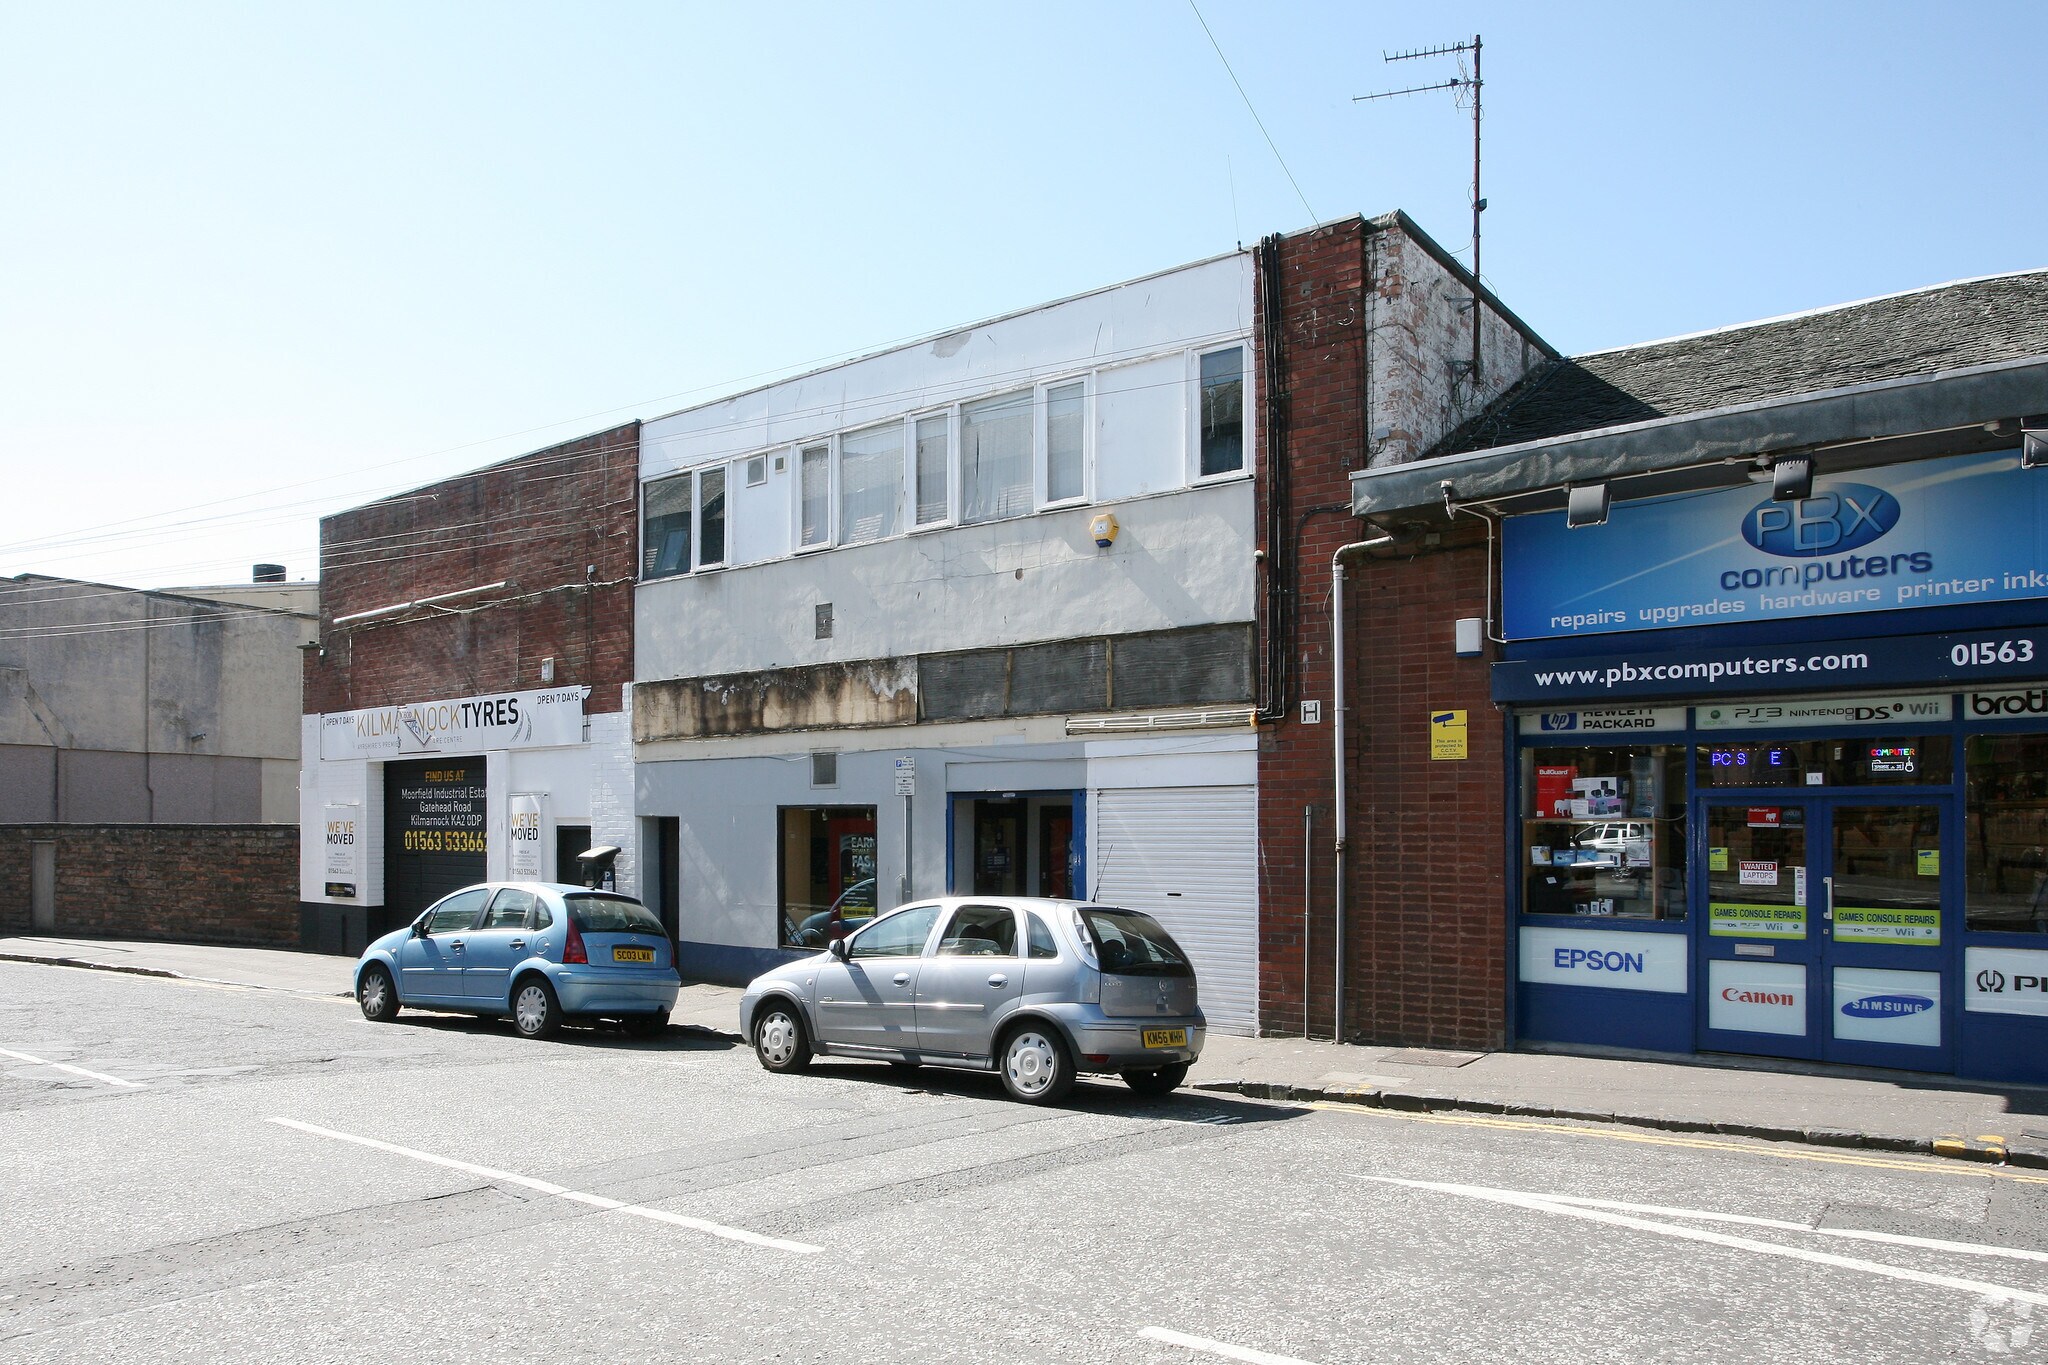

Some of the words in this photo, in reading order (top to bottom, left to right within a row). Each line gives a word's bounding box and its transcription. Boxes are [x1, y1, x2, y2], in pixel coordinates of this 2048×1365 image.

[1756, 491, 1884, 551] PBX
[1720, 552, 1933, 590] computers
[1551, 609, 1626, 630] repairs
[1639, 599, 1746, 624] upgrades
[1760, 588, 1881, 611] hardware
[1897, 578, 1995, 603] printer
[2003, 570, 2048, 590] ink
[1534, 652, 1868, 687] www.pbxcomputers.com
[1951, 640, 2034, 667] 01563
[537, 694, 555, 705] OPEN
[556, 693, 561, 703] 7
[562, 692, 579, 702] DAYS
[1303, 702, 1318, 722] H
[1735, 707, 1783, 718] PS3
[1790, 707, 1845, 718] NINTENDO
[1909, 702, 1939, 715] Wii
[326, 716, 339, 726] OPEN
[339, 716, 342, 725] 7
[343, 715, 354, 725] DAYS
[1550, 713, 1568, 730] hp
[1583, 718, 1655, 730] PACKARD
[1712, 752, 1732, 766] PC
[1736, 752, 1746, 766] S
[1770, 751, 1781, 765] E
[1870, 748, 1915, 757] COMPUTER
[425, 770, 443, 782] FIND
[443, 770, 454, 782] US
[455, 769, 465, 781] AT
[401, 787, 433, 800] Moorfield
[434, 786, 467, 799] Industrial
[420, 801, 452, 813] Gatehead
[453, 800, 472, 812] Road
[411, 814, 450, 826] Kilmarnock
[451, 814, 465, 826] KA2
[511, 813, 538, 827] WE'VE
[327, 821, 354, 833] WE'VE
[511, 827, 538, 840] MOVED
[327, 833, 354, 845] MOVED
[404, 830, 442, 851] 01563
[604, 871, 611, 880] P
[1743, 871, 1774, 879] LAPTOPS
[1714, 908, 1738, 918] GAMES
[1739, 908, 1772, 919] CONSOLE
[1773, 910, 1802, 919] REPAIRS
[1838, 912, 1864, 922] GAMES
[1866, 913, 1902, 924] CONSOLE
[1904, 914, 1935, 925] REPAIRS
[1765, 922, 1783, 931] Wii
[1895, 927, 1915, 936] Wii
[616, 950, 637, 960] SC03
[1554, 948, 1643, 973] EPSON
[1722, 987, 1794, 1006] Canon
[1852, 999, 1923, 1014] SAMSUNG
